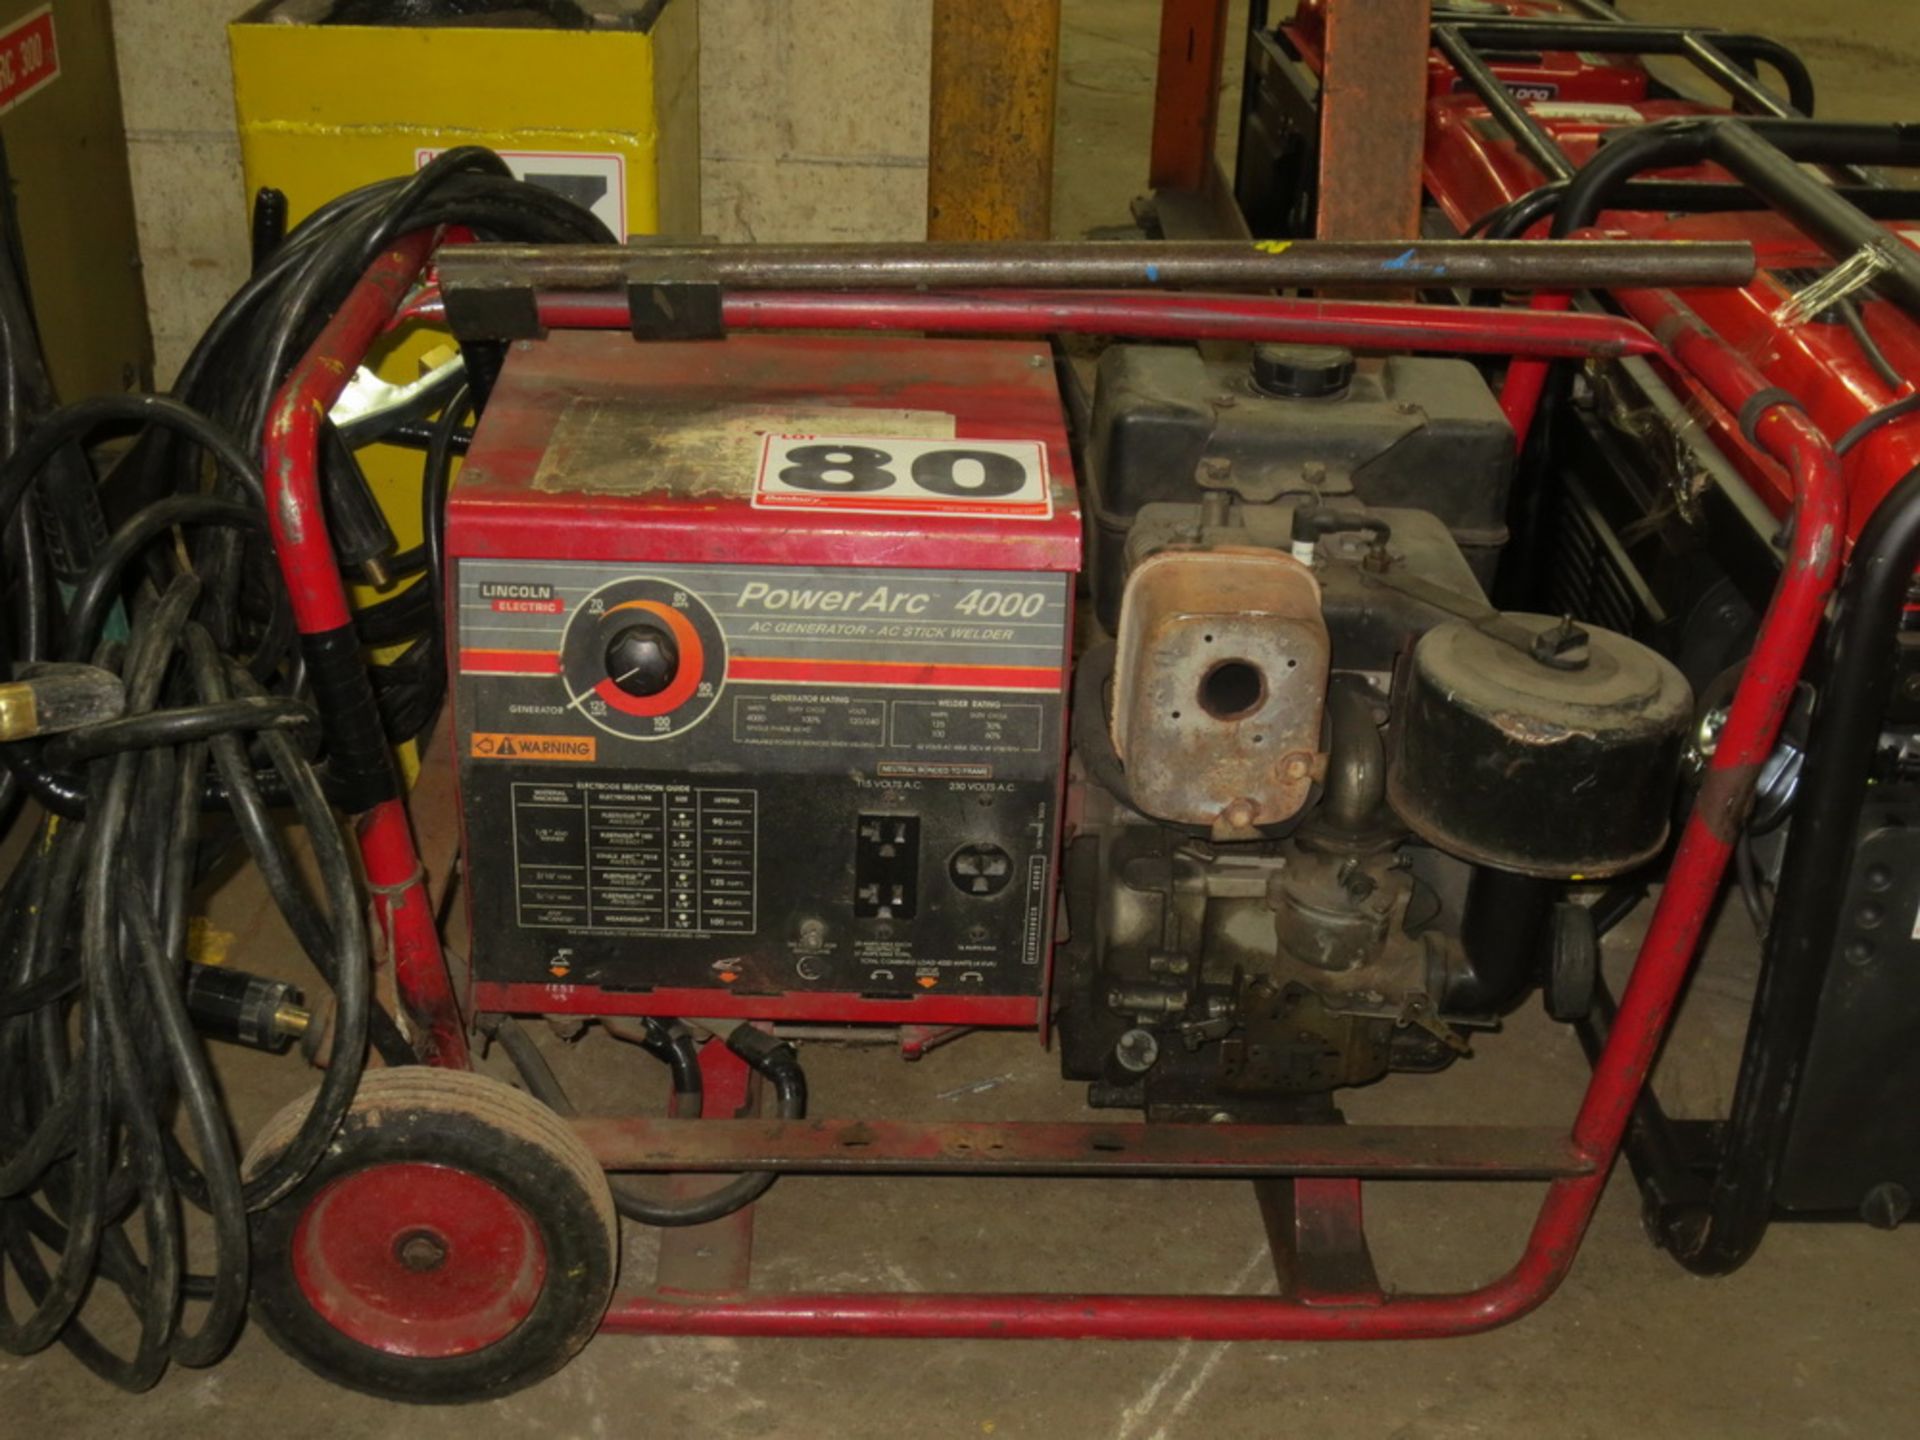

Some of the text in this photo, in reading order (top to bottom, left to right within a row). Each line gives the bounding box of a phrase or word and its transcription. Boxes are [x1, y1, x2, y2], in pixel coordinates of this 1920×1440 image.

[779, 445, 1026, 497] 80
[482, 585, 551, 598] LINCOLN
[673, 592, 686, 602] 80
[499, 601, 556, 612] ELECTRIC
[590, 599, 604, 609] 70
[954, 588, 1046, 618] 4000
[749, 621, 772, 633] AC
[774, 622, 866, 636] GENERATOR
[878, 625, 900, 637] AC
[903, 626, 947, 639] STICK
[950, 628, 1015, 641] WELDER
[699, 683, 712, 693] 90
[769, 694, 850, 704] GENERATOR RATING
[938, 699, 1001, 709] WELDER RATING
[509, 704, 564, 715] GENERATOR
[590, 701, 606, 711] 125
[653, 717, 671, 726] 100
[519, 741, 591, 756] WARNING
[882, 765, 916, 774] NEUTRAL
[576, 782, 690, 793] ELECTRODE SELECTION GUIDE
[874, 780, 901, 789] VOLTS
[949, 782, 966, 791] 230
[968, 782, 995, 791] VOLTS
